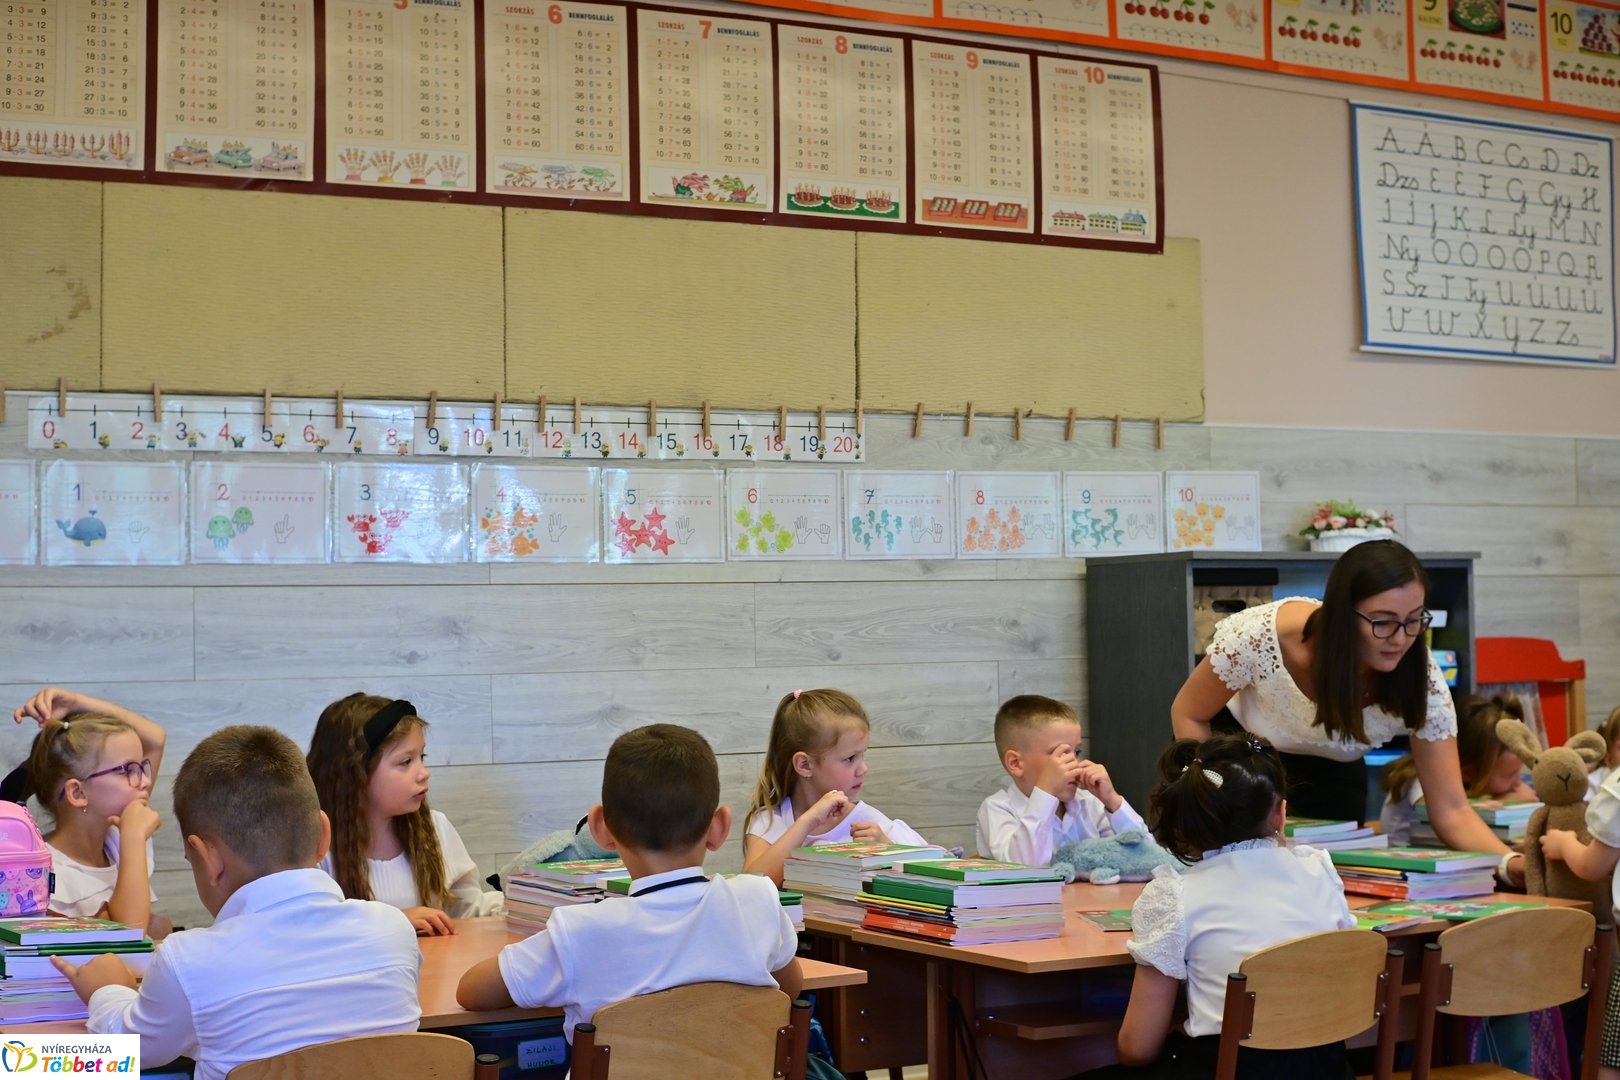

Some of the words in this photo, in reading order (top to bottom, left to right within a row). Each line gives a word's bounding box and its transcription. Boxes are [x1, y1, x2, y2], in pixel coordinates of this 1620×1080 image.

[548, 4, 563, 24] 6
[1549, 11, 1573, 35] 10
[699, 20, 713, 39] 7
[834, 35, 848, 54] 8
[966, 51, 979, 69] 9
[1084, 66, 1105, 85] 10
[1376, 127, 1405, 153] A
[1451, 135, 1467, 161] B
[1476, 139, 1493, 164] C
[1504, 143, 1530, 169] Cs
[1540, 147, 1560, 173] D
[1571, 152, 1600, 179] Dz
[1377, 162, 1419, 190] Dzs
[1430, 167, 1441, 193] E
[1478, 173, 1493, 198] F
[1506, 177, 1527, 215] G
[1538, 181, 1572, 220] Gy
[1581, 187, 1601, 212] H
[1450, 205, 1472, 231] K
[1480, 209, 1496, 234] L
[1508, 212, 1536, 250] Ly
[1545, 217, 1570, 242] M
[1580, 220, 1602, 246] N
[1383, 233, 1420, 273] Ny
[1432, 238, 1452, 264] O
[1537, 249, 1551, 274] P
[1557, 251, 1578, 277] Q
[1584, 254, 1603, 280] R
[1383, 269, 1395, 295] S
[1405, 271, 1428, 298] Sz
[1440, 274, 1455, 300] T
[1464, 276, 1488, 315] Ty
[1496, 280, 1520, 307] U
[1424, 309, 1461, 336] W
[1470, 313, 1493, 340] X
[1529, 318, 1545, 344] Z
[1556, 320, 1580, 346] Zs
[42, 421, 55, 439] 0
[89, 422, 97, 439] 1
[131, 422, 144, 439] 2
[176, 422, 188, 441] 3
[218, 423, 231, 440] 4
[262, 425, 273, 442] 5
[303, 425, 315, 443] 6
[346, 426, 357, 445] 7
[386, 428, 398, 446] 8
[428, 428, 440, 445] 9
[464, 429, 484, 447] 10
[503, 430, 523, 447] 11
[541, 431, 563, 449] 12
[581, 431, 602, 449] 13
[619, 432, 639, 450] 14
[657, 433, 678, 450] 15
[694, 432, 713, 450] 16
[730, 434, 749, 451] 17
[764, 435, 784, 451] 18
[800, 436, 819, 452] 19
[833, 436, 853, 453] 20
[73, 484, 82, 500] 1
[217, 484, 230, 500] 2
[360, 485, 372, 501] 3
[626, 489, 637, 505] 5
[747, 489, 758, 503] 6
[864, 489, 875, 504] 7
[975, 490, 985, 505] 8
[1082, 490, 1091, 504] 9
[1178, 488, 1194, 502] 10
